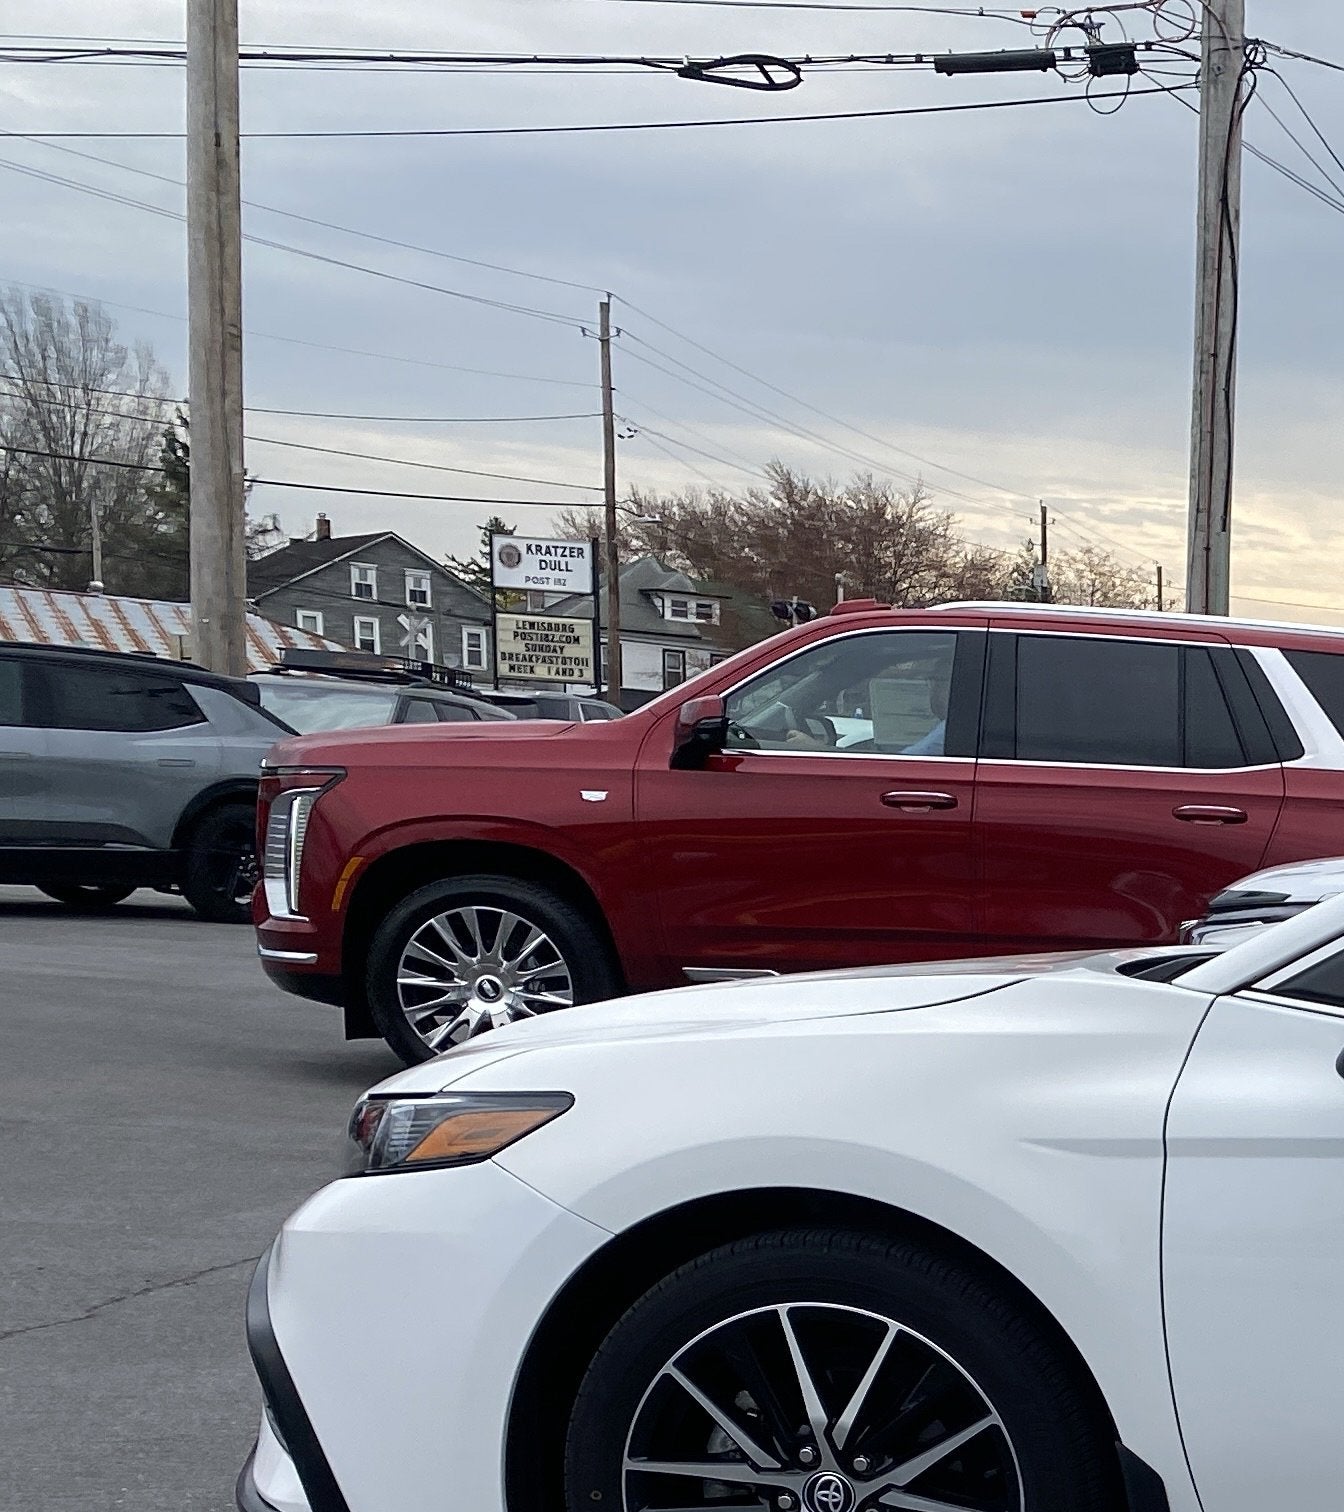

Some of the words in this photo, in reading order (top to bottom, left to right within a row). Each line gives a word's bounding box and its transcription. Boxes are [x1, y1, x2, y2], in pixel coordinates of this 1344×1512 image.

[526, 543, 585, 559] KRATZER
[539, 559, 573, 573] DULL
[524, 575, 551, 586] POST
[515, 619, 575, 634] LEWISBURG
[524, 642, 565, 655] SUNDAY
[508, 663, 535, 675] WEEK
[554, 667, 575, 677] AND
[577, 668, 584, 678] 3
